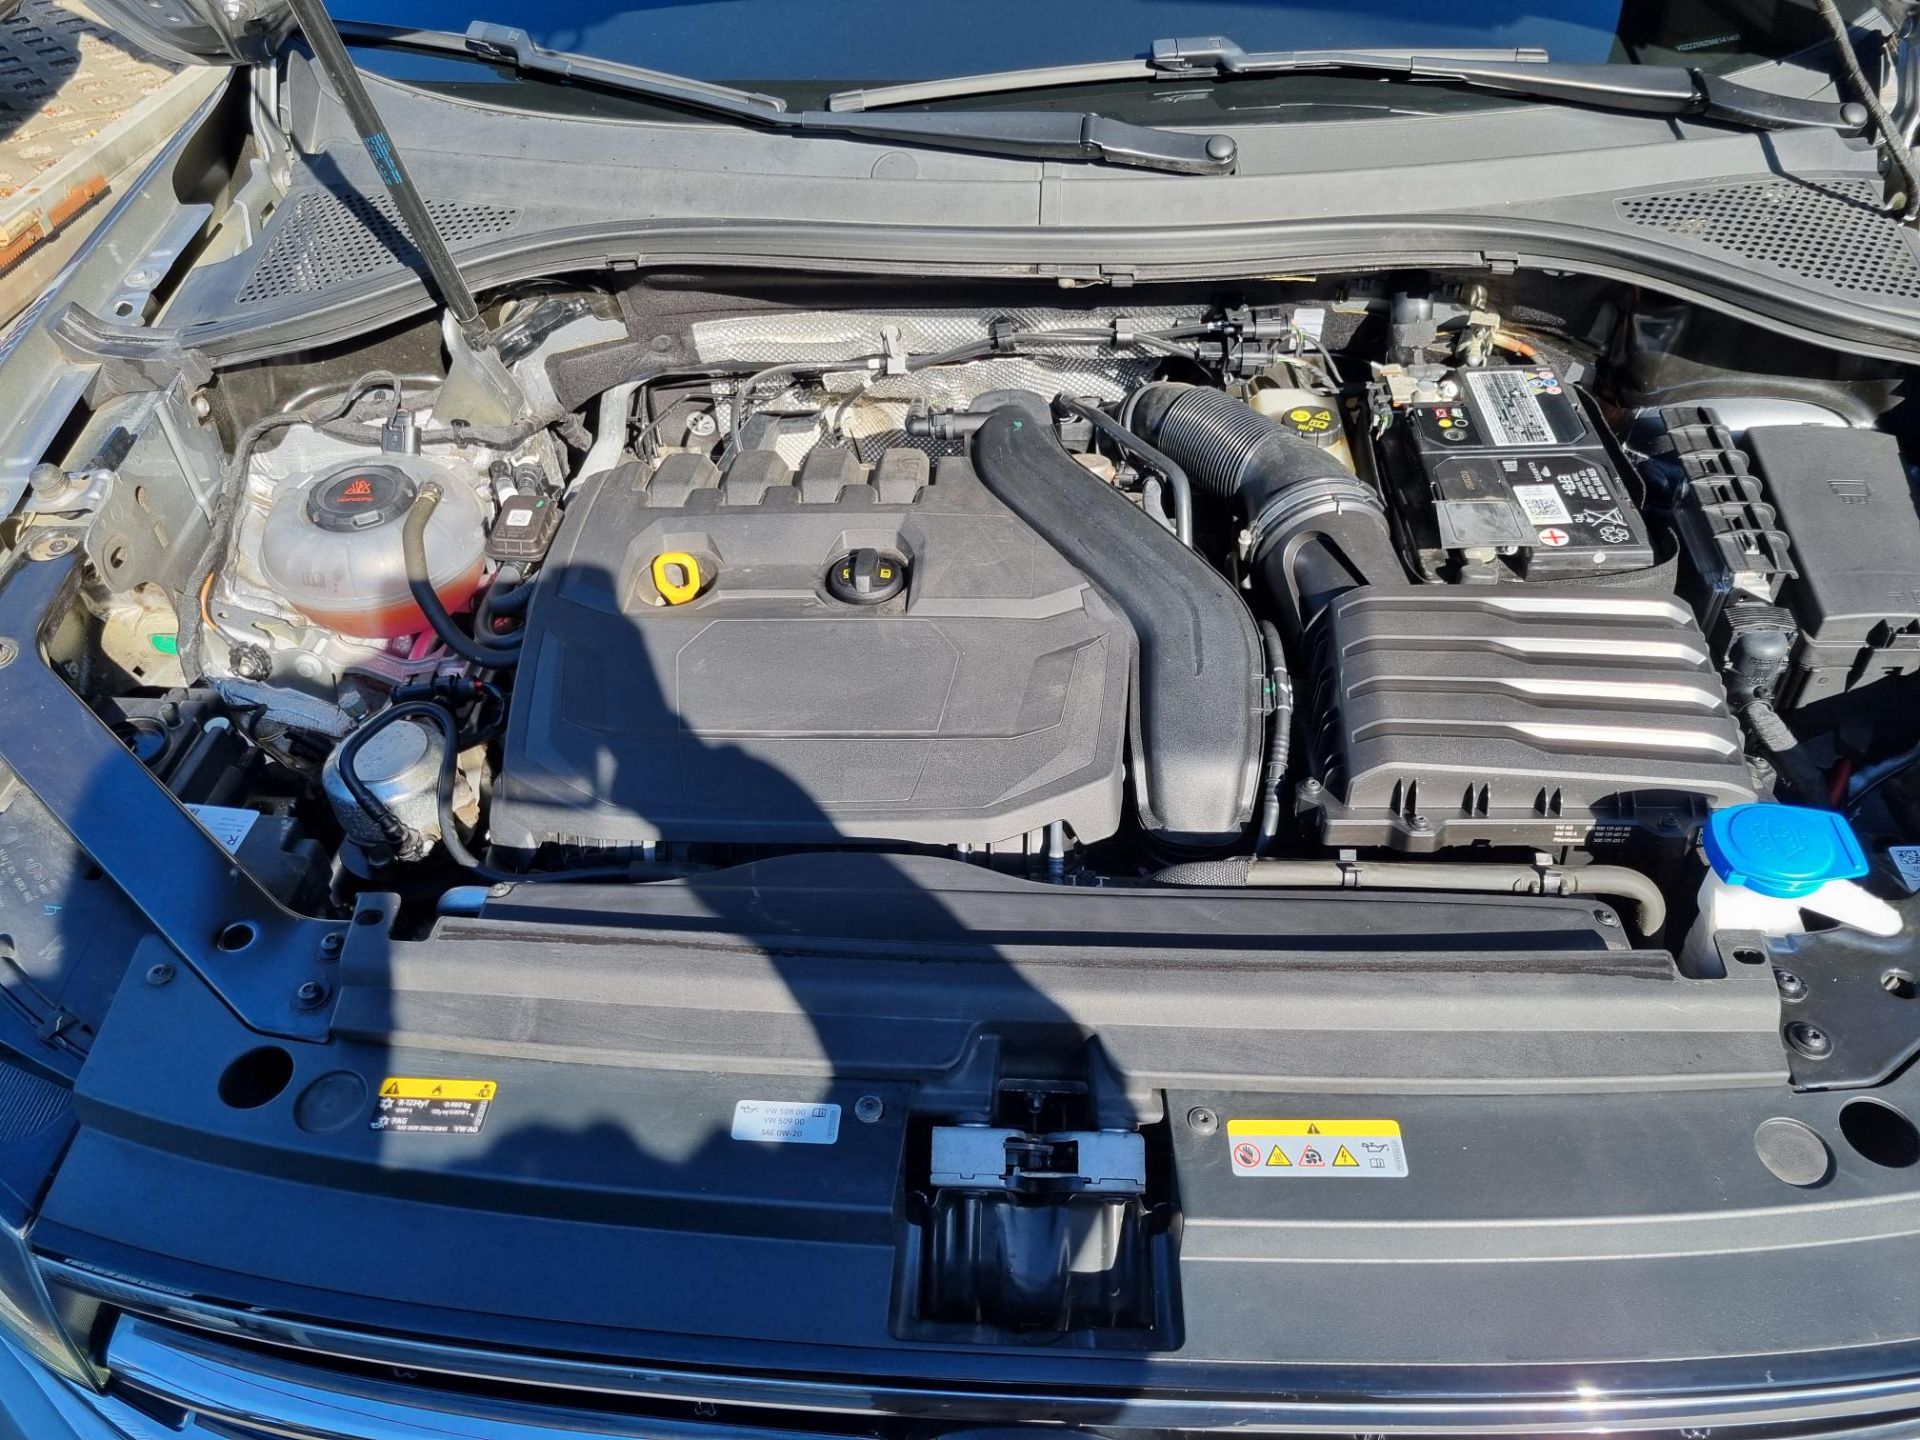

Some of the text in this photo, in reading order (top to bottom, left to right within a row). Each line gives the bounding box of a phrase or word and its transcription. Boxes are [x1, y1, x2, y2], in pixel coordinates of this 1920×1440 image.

[1557, 474, 1577, 496] EFB+
[226, 835, 240, 846] R
[397, 1099, 430, 1108] R-1234yf
[795, 1108, 807, 1116] 00
[390, 1117, 408, 1125] PAG
[778, 1117, 793, 1125] 509
[794, 1118, 806, 1126] 00
[761, 1128, 803, 1137] SAE 0W-20
